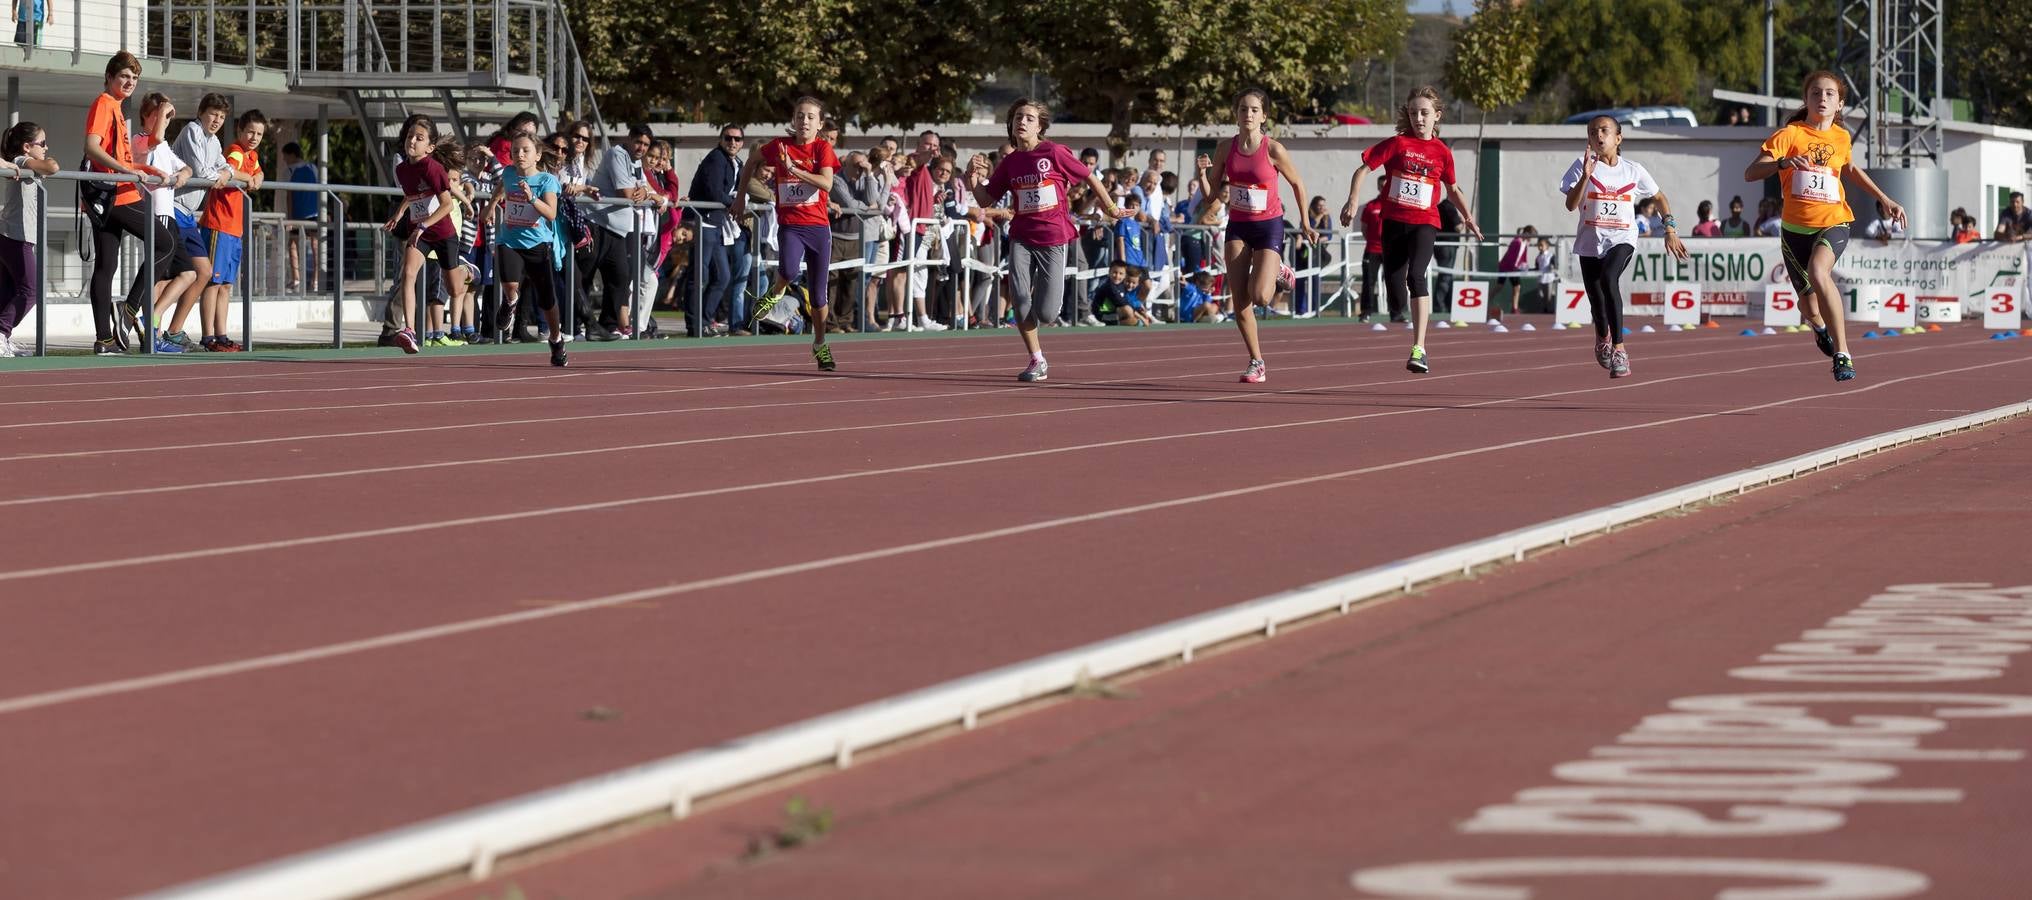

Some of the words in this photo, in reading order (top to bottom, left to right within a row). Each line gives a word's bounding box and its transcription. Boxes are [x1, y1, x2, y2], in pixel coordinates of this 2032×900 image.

[1401, 182, 1418, 196] 33
[1809, 175, 1824, 190] 31
[788, 185, 803, 197] 36
[1026, 191, 1040, 204] 35
[1237, 190, 1250, 202] 34
[415, 202, 426, 213] 38
[511, 205, 524, 216] 37
[1600, 202, 1617, 215] 32
[1632, 253, 1765, 282] ATLETISMO
[1851, 256, 1898, 270] Hazte
[1904, 257, 1957, 274] grande
[1869, 274, 1936, 290] nosotros
[1458, 288, 1481, 308] 8
[1565, 290, 1585, 309] 7
[1671, 291, 1696, 309] 6
[1772, 292, 1794, 310] 5
[1843, 288, 1857, 312] 1
[1884, 293, 1910, 313] 4
[1991, 293, 2014, 313] 3
[1920, 306, 1930, 318] 3
